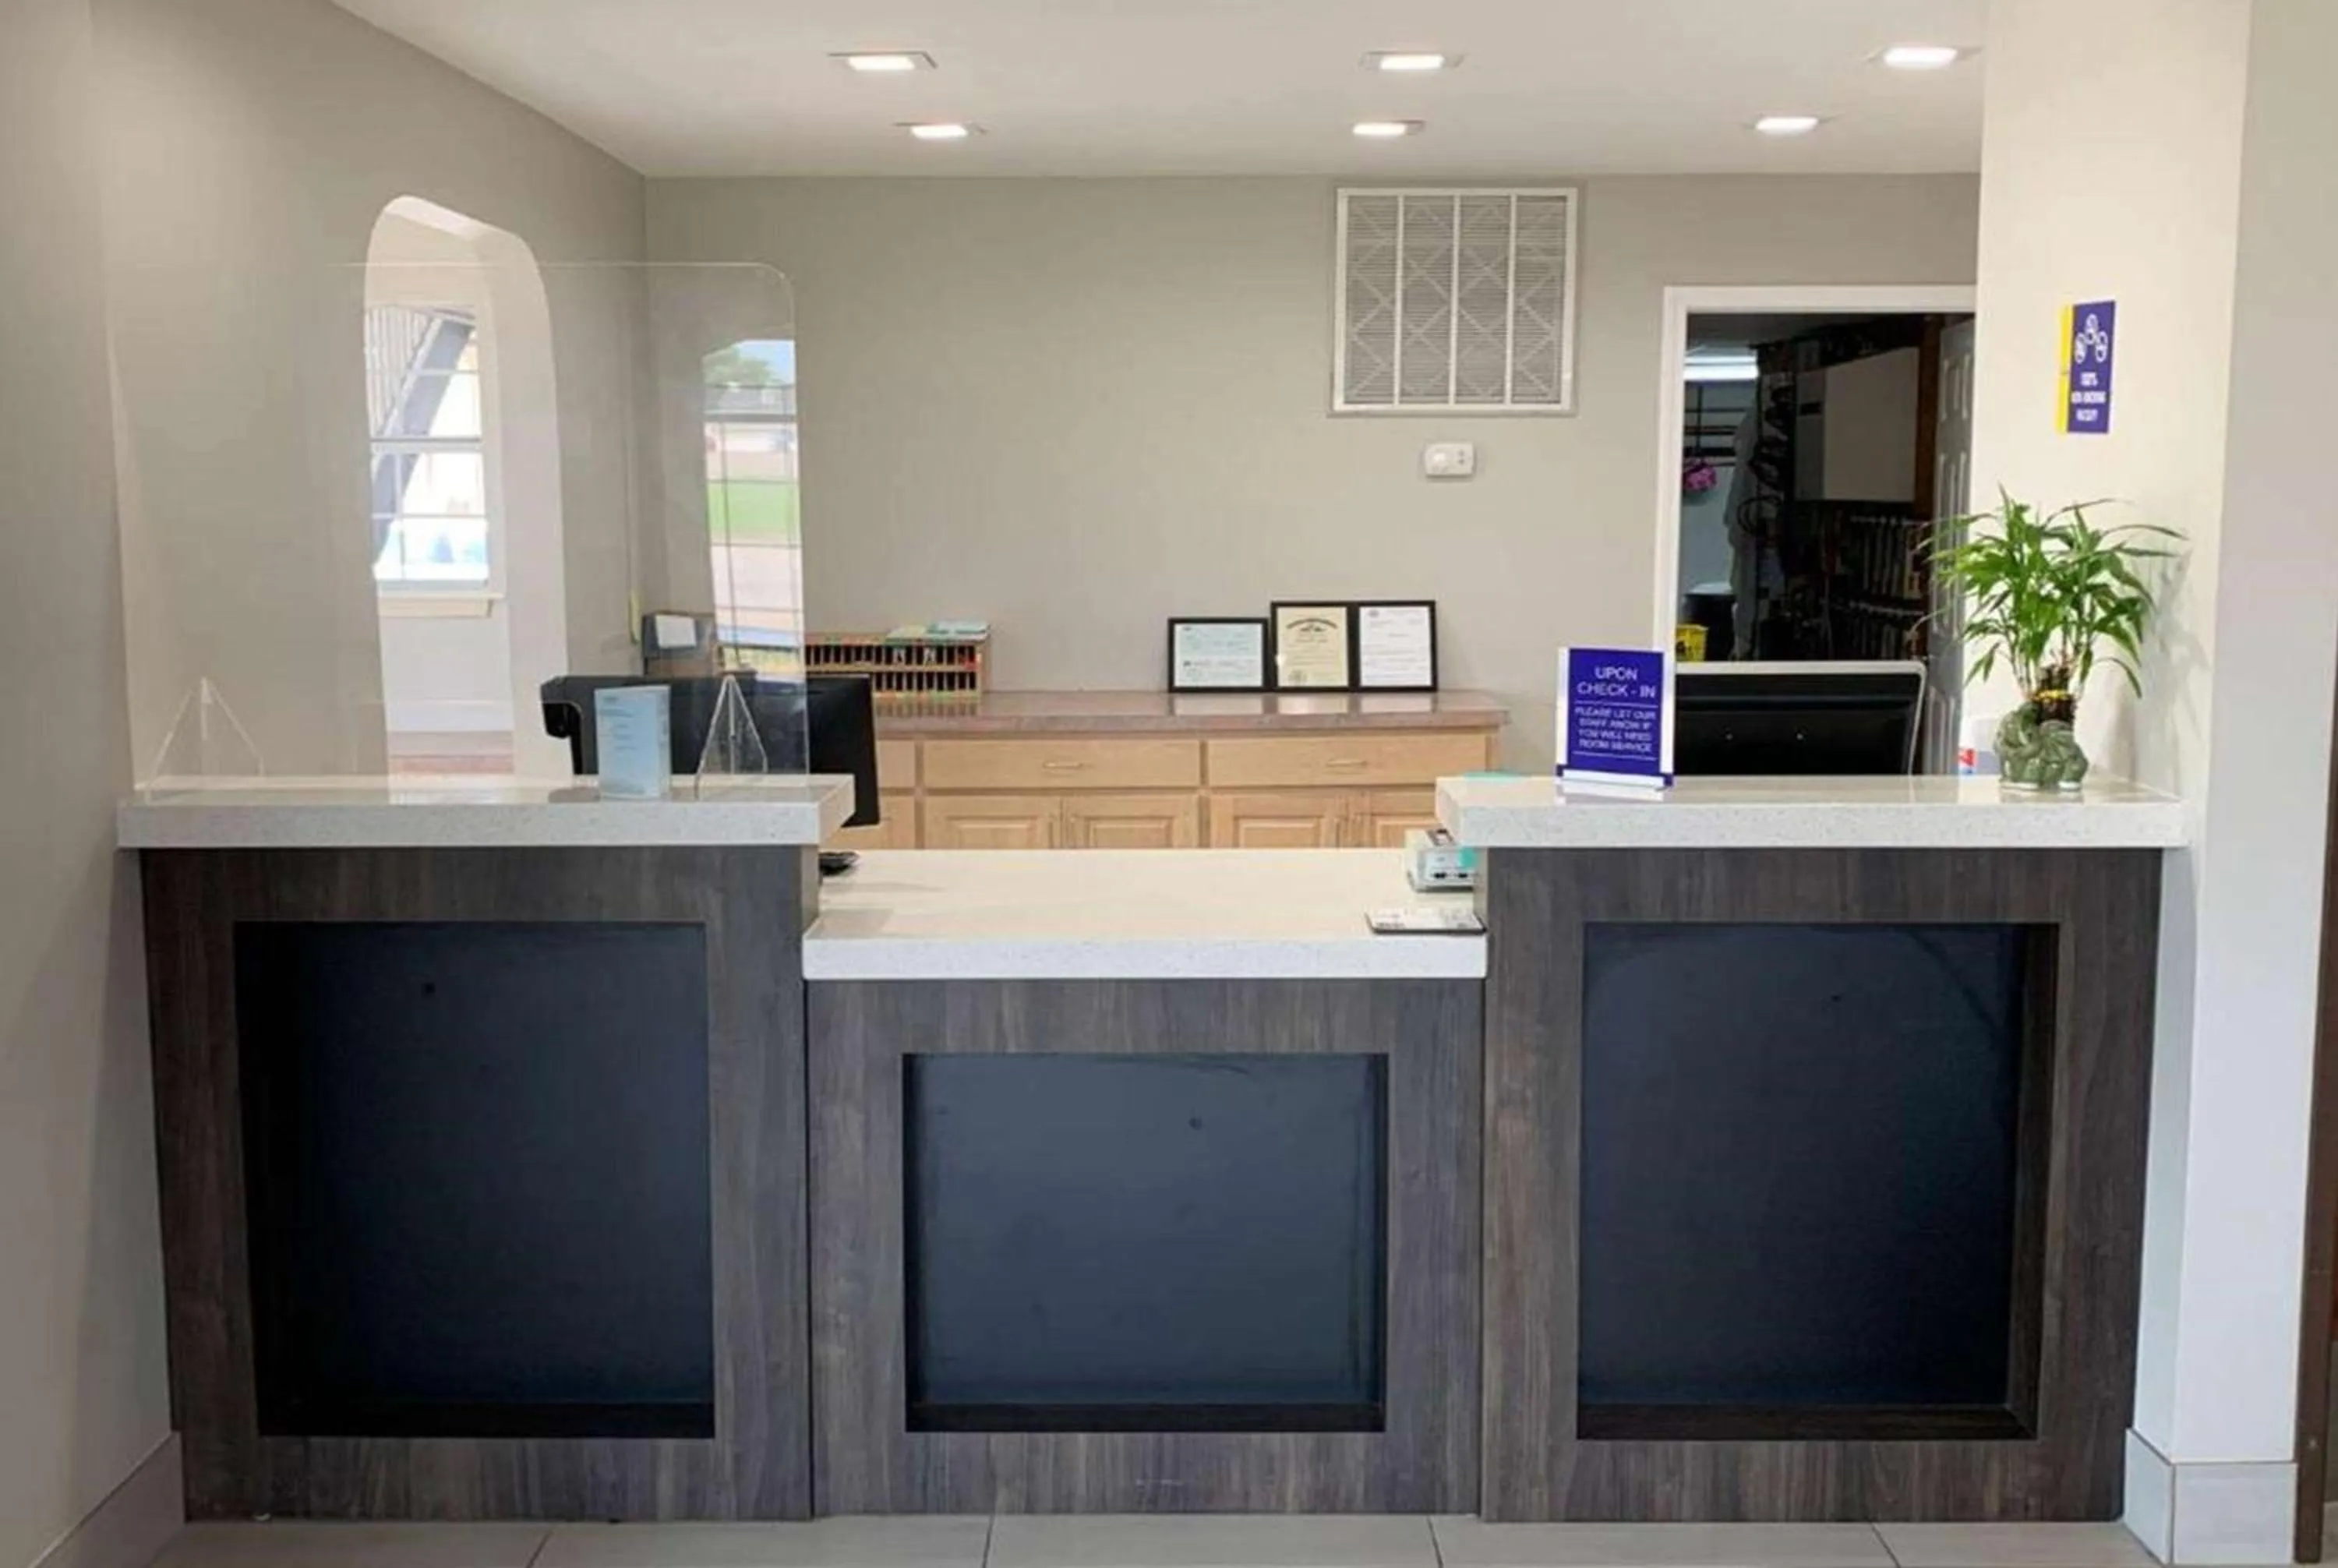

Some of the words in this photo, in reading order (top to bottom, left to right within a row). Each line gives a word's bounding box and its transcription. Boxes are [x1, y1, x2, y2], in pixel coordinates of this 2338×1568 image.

[1594, 666, 1639, 680] UPON
[1577, 681, 1628, 697] CHECK
[1640, 684, 1656, 698] IN
